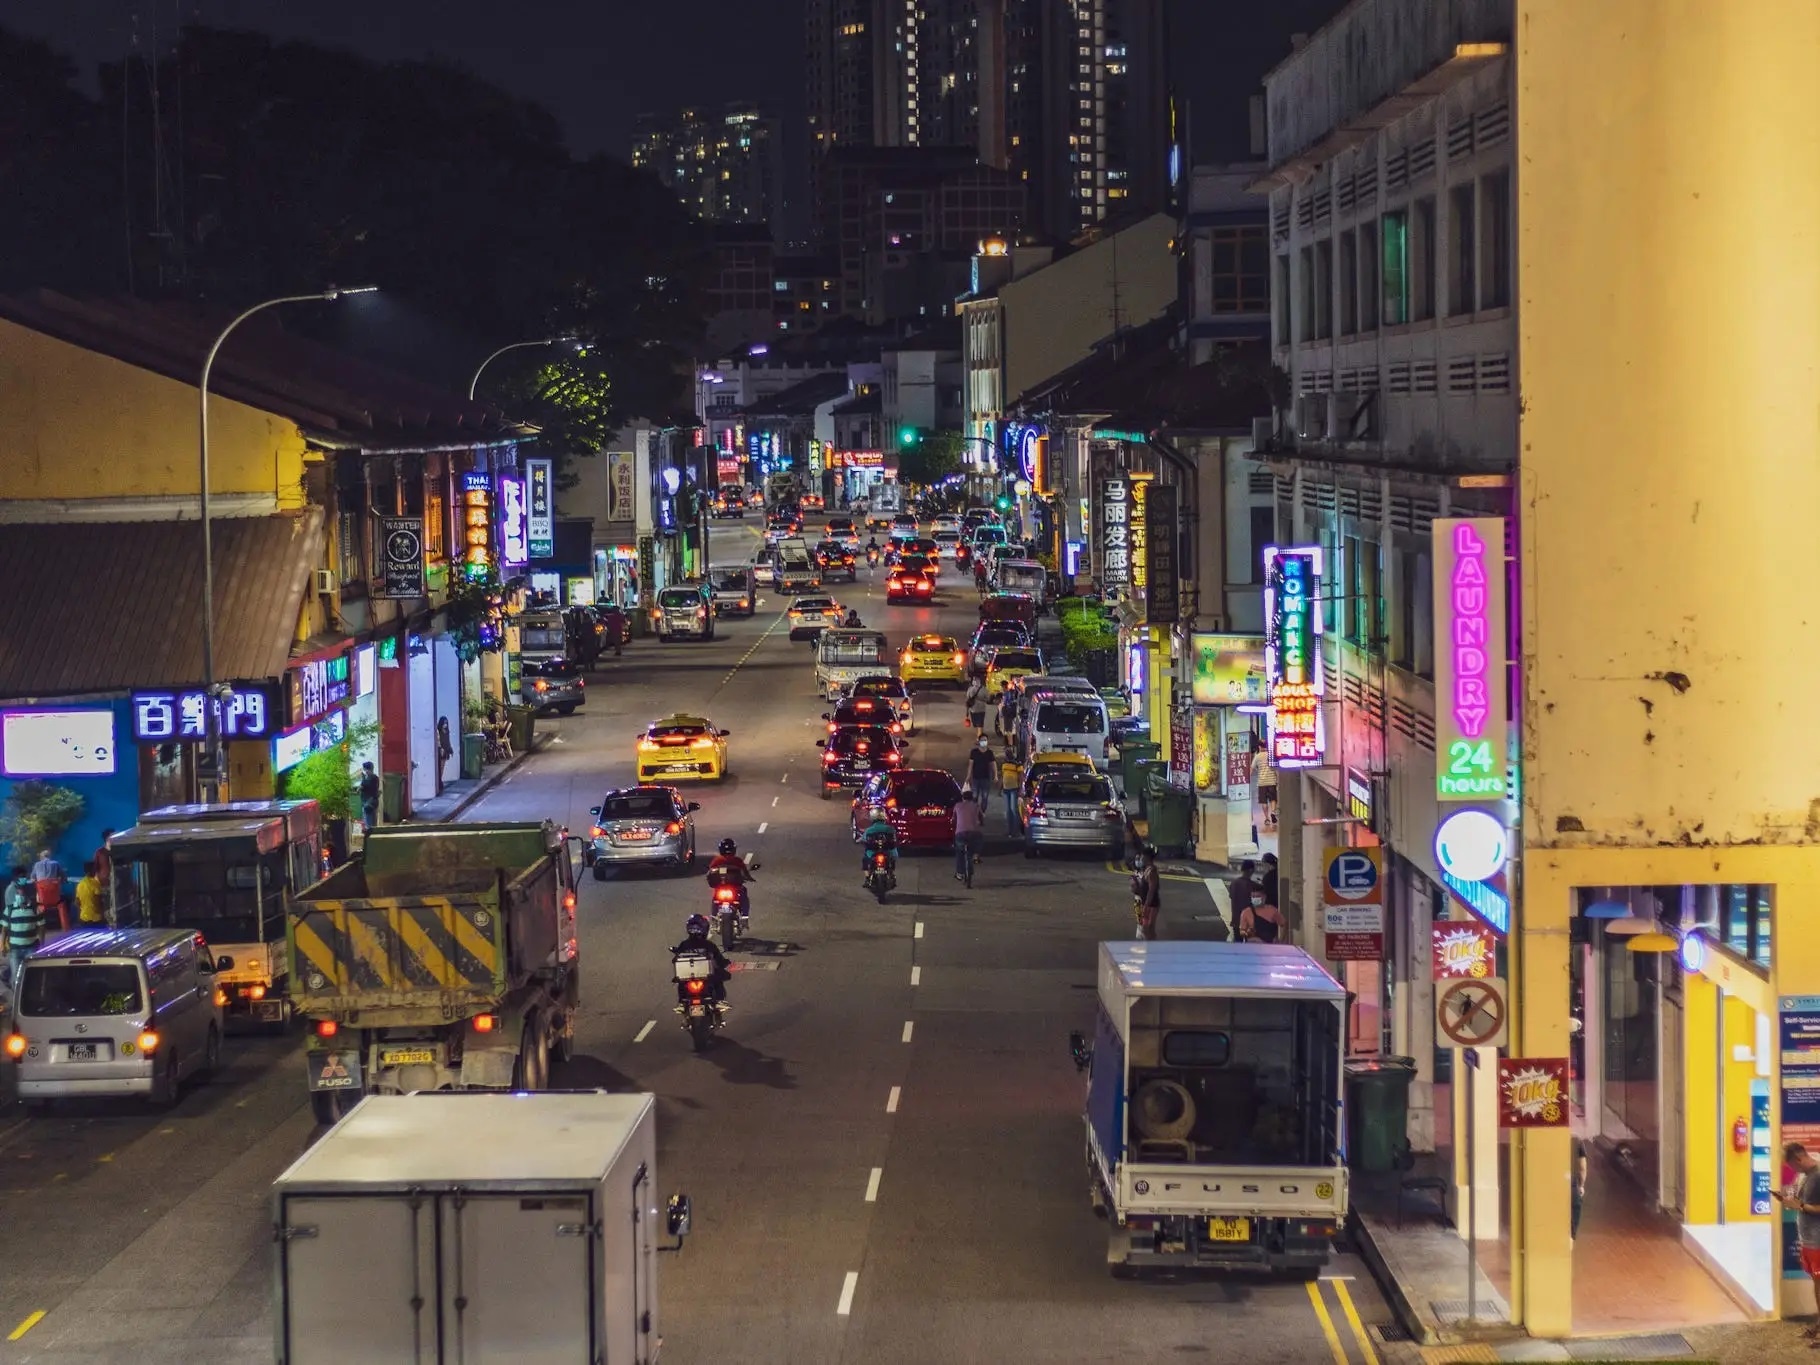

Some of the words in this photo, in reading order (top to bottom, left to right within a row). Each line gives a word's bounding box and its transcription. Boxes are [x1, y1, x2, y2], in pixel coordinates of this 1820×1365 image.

[1104, 480, 1127, 569] 马丽发廊
[387, 561, 420, 571] Reward
[1456, 526, 1487, 738] LAUNDRY
[1274, 697, 1316, 710] SHOP
[1449, 741, 1493, 775] 24
[1441, 776, 1503, 793] hours
[1339, 855, 1370, 888] P
[1512, 1080, 1558, 1108] 10kg
[1165, 1183, 1298, 1194] FUSO
